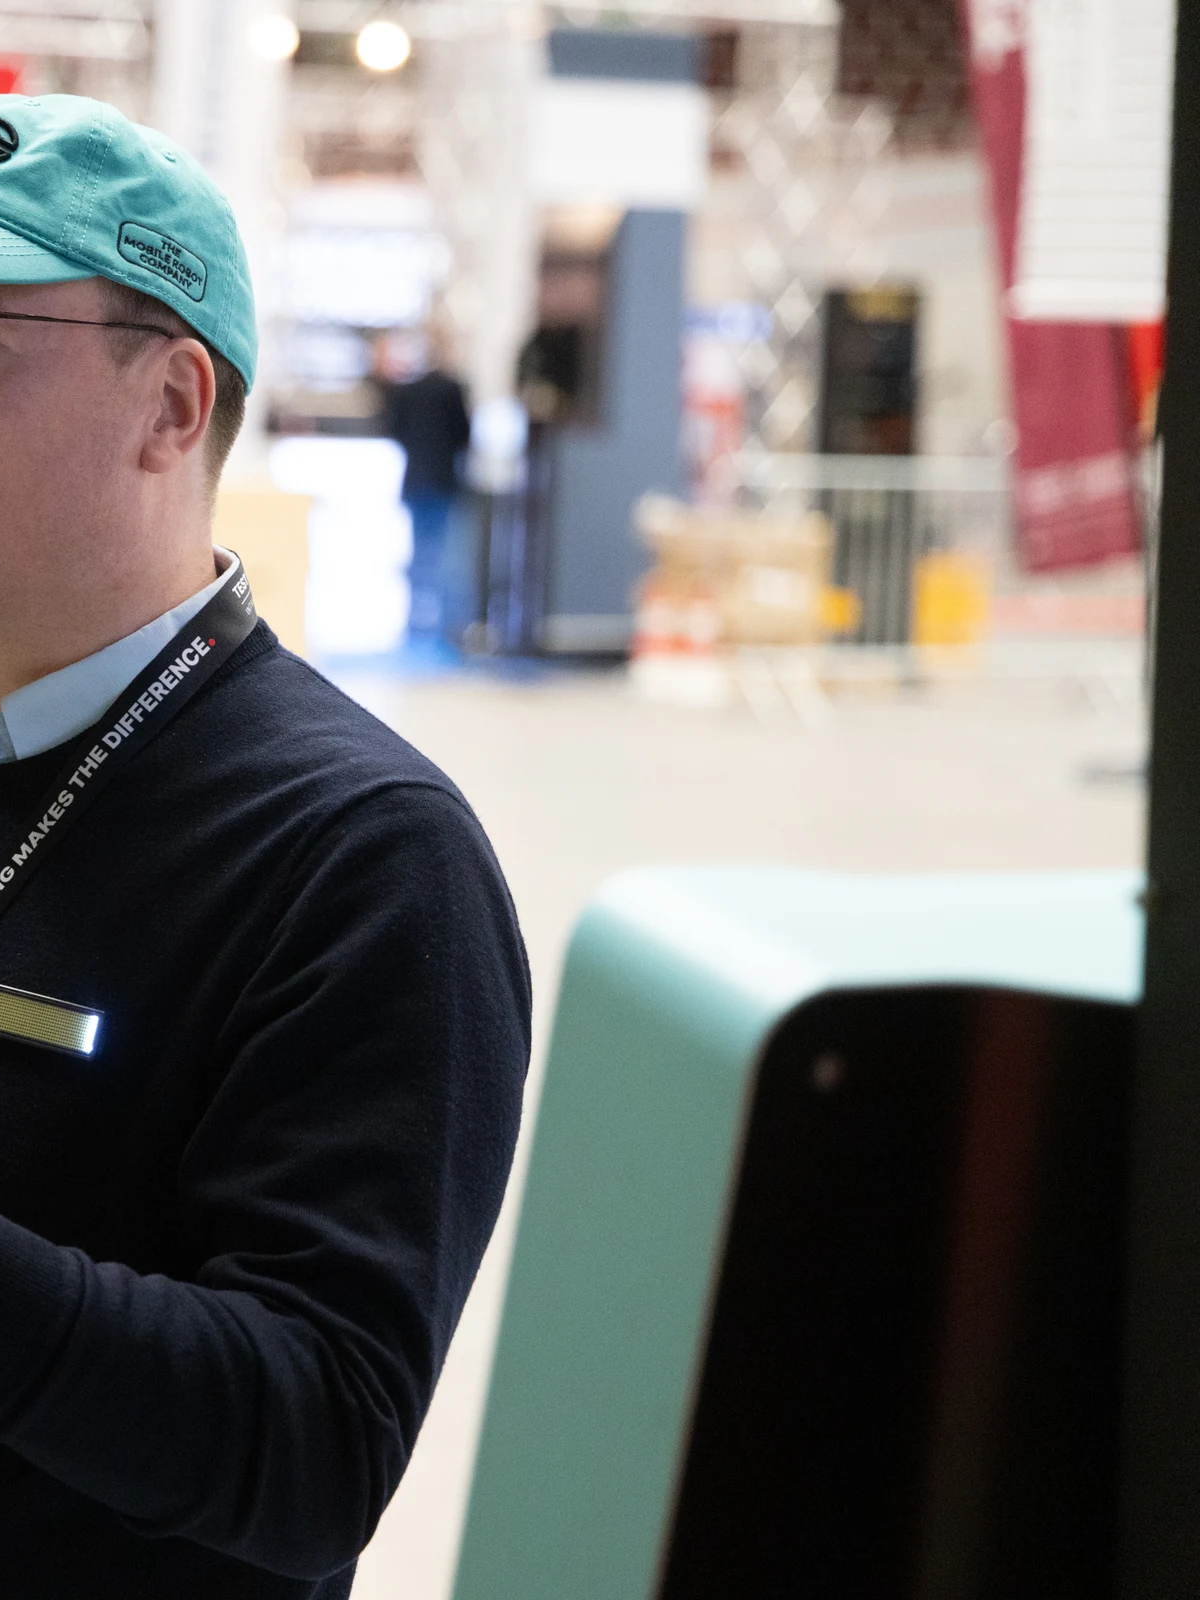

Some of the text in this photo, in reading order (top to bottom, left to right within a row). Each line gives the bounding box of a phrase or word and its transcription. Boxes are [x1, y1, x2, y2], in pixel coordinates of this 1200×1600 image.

[123, 235, 203, 287] MOBILE ROBOT
[139, 253, 193, 289] COMPANY
[160, 240, 182, 259] THE
[11, 789, 75, 867] MAKES
[68, 744, 109, 788] THE
[101, 635, 216, 749] DIFFERENCE.
